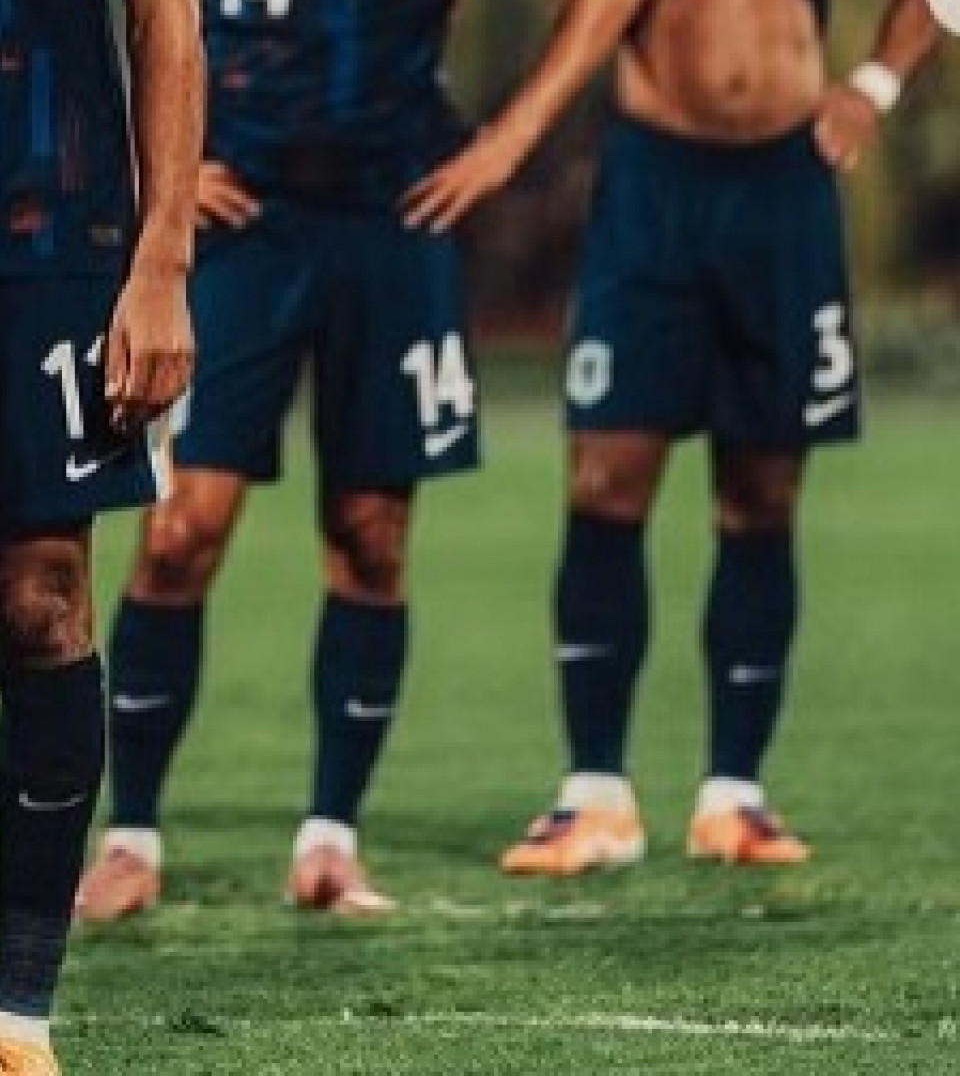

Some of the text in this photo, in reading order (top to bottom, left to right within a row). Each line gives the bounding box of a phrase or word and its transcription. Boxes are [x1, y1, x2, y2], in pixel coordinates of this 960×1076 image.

[41, 338, 105, 439] 1
[401, 332, 474, 427] 14
[812, 303, 853, 391] 3
